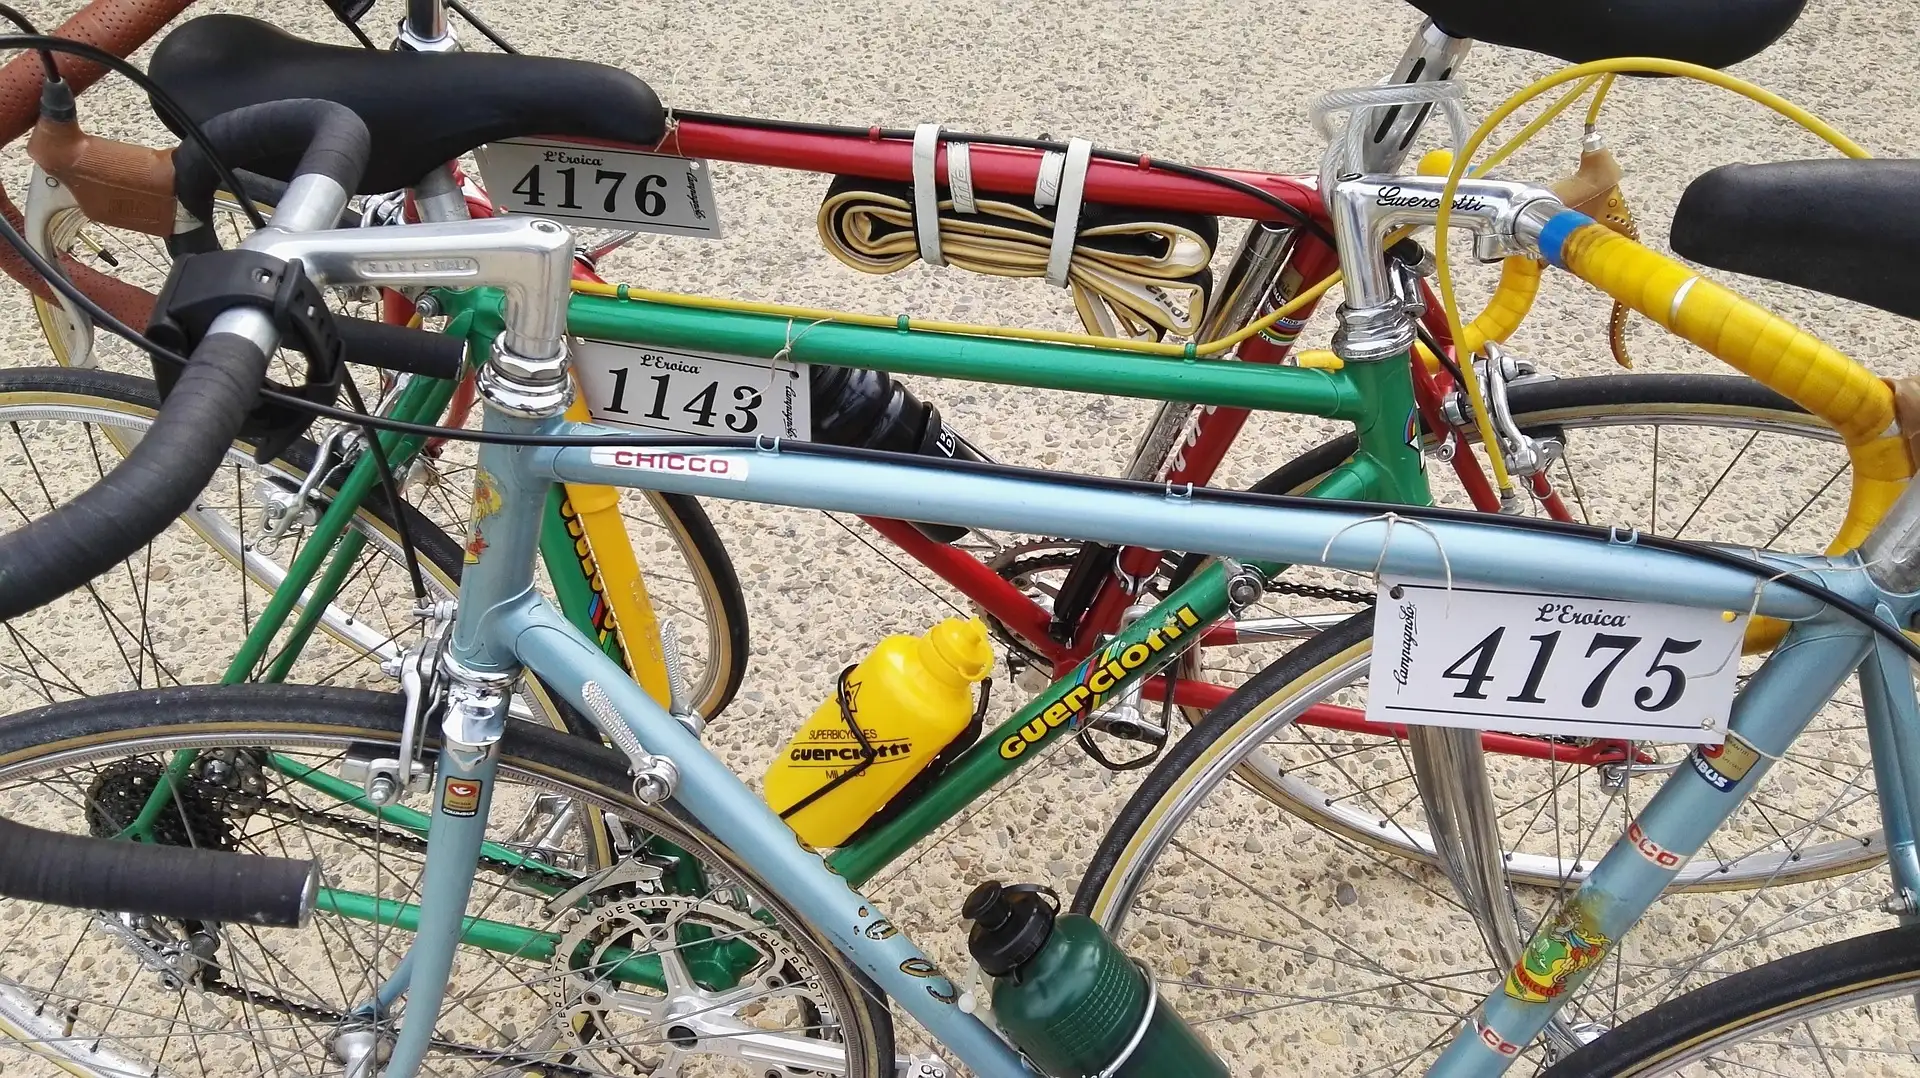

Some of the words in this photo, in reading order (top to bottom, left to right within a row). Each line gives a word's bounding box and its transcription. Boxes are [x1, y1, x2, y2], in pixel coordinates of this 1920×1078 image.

[543, 150, 604, 167] L'Eroica
[512, 164, 668, 217] 4176
[1376, 186, 1486, 211] Guercotti
[640, 354, 702, 375] L'Eroica
[603, 367, 763, 433] 1143
[614, 451, 729, 474] CHICCO
[1535, 603, 1630, 628] L'Eroica
[1393, 601, 1419, 695] Campagnolo
[1442, 627, 1702, 713] 4175
[808, 729, 878, 741] SUPERBICYCES
[825, 769, 866, 780] MILO
[1691, 750, 1728, 788] MBUS
[597, 899, 700, 923] GUERCIOTTI
